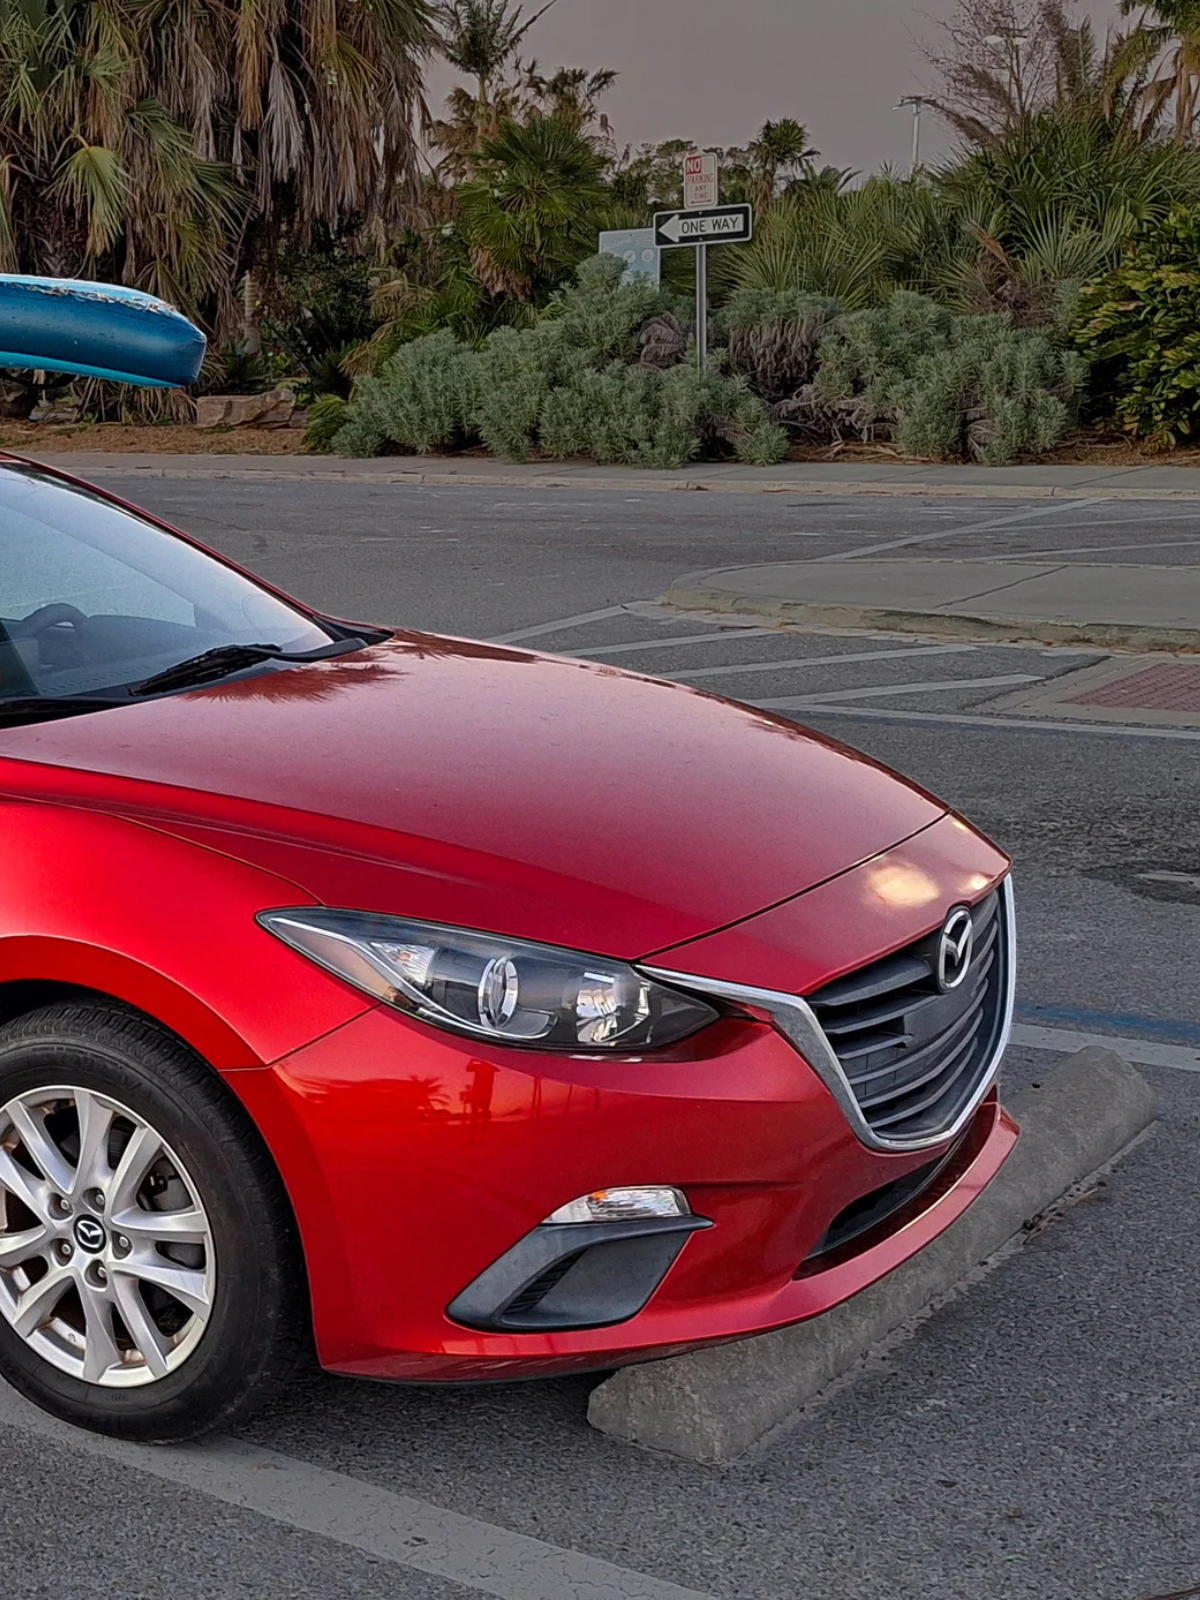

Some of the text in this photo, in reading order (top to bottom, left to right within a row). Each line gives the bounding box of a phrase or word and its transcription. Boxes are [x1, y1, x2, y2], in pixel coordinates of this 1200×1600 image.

[686, 158, 700, 173] NO
[687, 174, 714, 184] PARKING
[681, 217, 739, 234] ONE WAY
